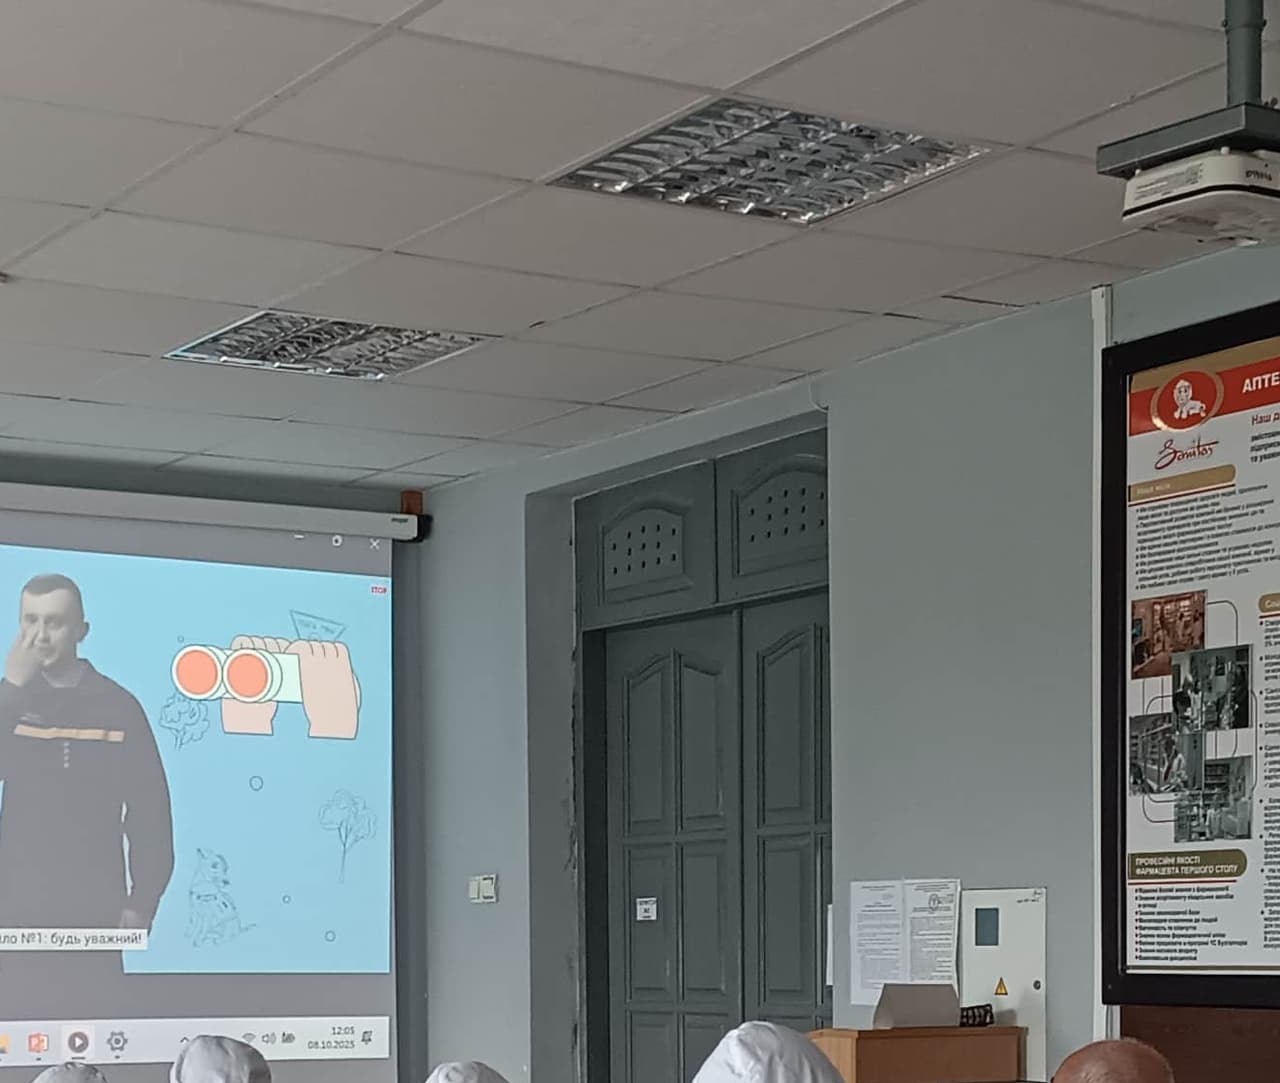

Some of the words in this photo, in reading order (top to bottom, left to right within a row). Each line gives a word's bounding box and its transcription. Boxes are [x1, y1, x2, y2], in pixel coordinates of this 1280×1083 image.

[1251, 412, 1271, 425] Наш
[21, 933, 48, 944] №1:
[51, 932, 81, 946] будь
[84, 932, 142, 947] уважний!
[331, 1027, 355, 1035] 12:05
